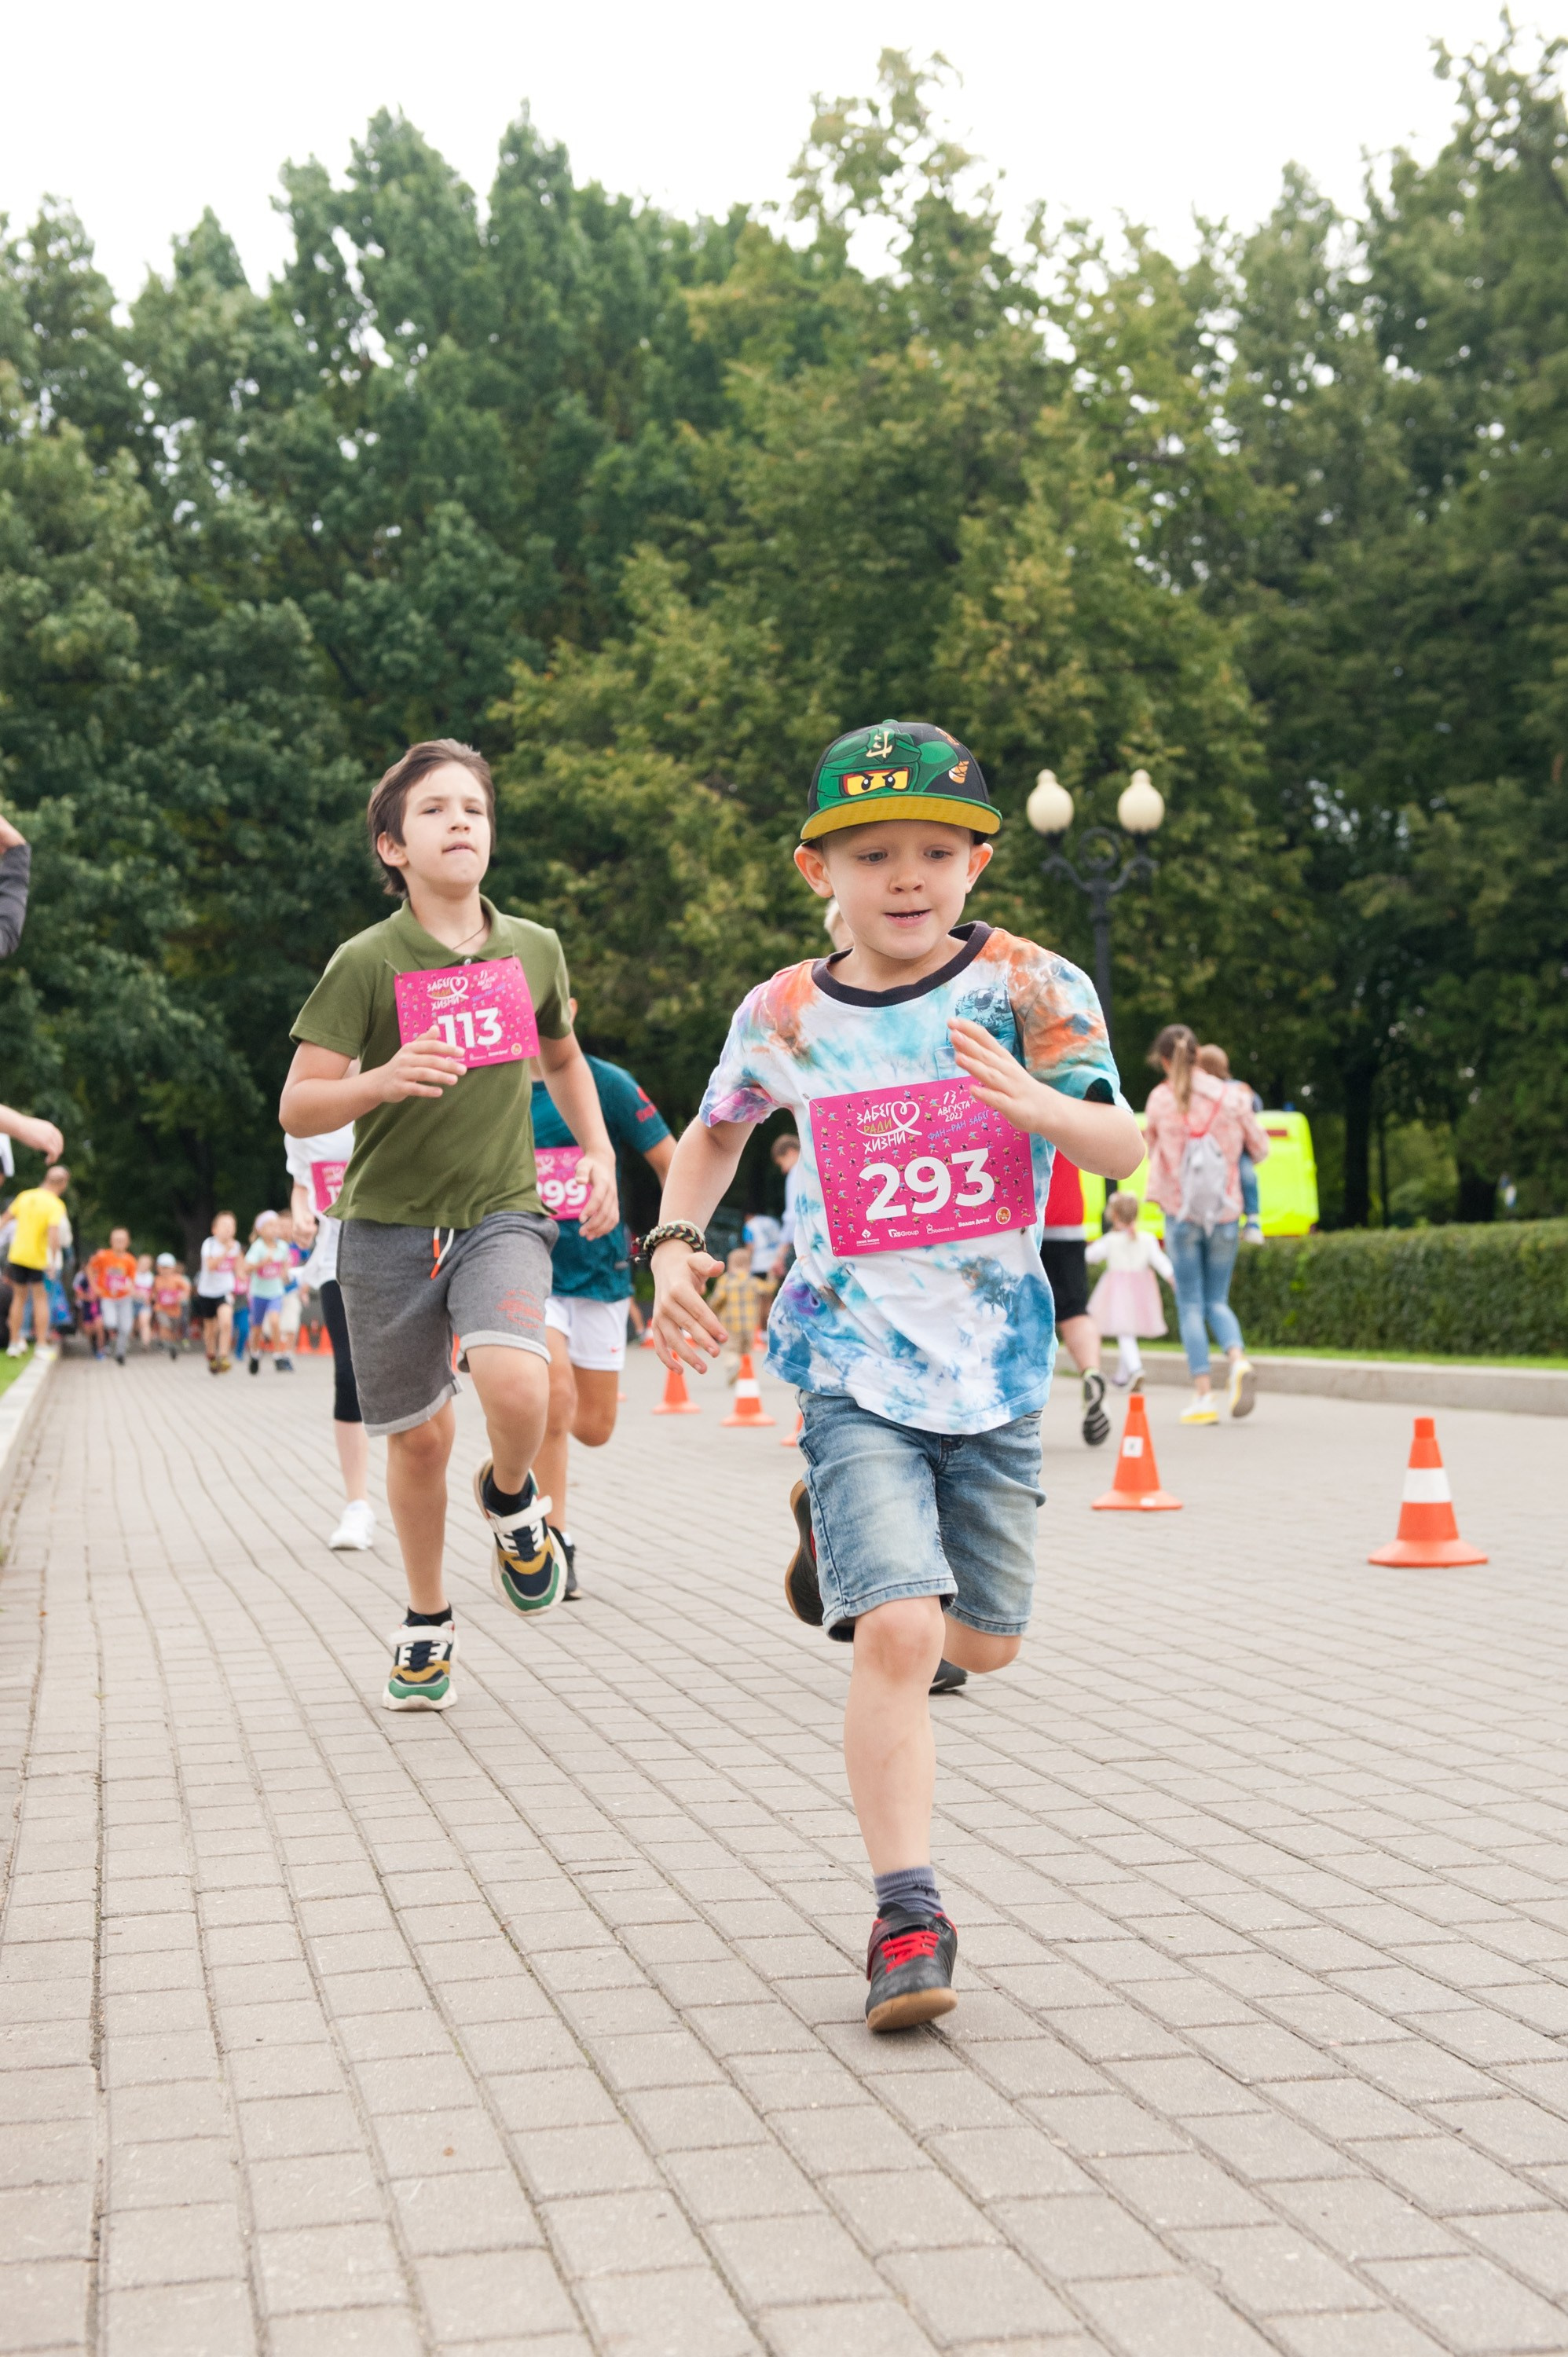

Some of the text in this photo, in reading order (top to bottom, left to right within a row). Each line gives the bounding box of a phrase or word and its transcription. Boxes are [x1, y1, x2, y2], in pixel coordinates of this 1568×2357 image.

[438, 1007, 503, 1048] 113
[938, 1101, 971, 1116] АВГУСТА
[943, 1089, 956, 1105] 13
[857, 1102, 892, 1125] ЗАБЕГ
[864, 1118, 892, 1133] РАДИ
[863, 1131, 906, 1156] ЖИЗНИ
[859, 1148, 995, 1220] 293
